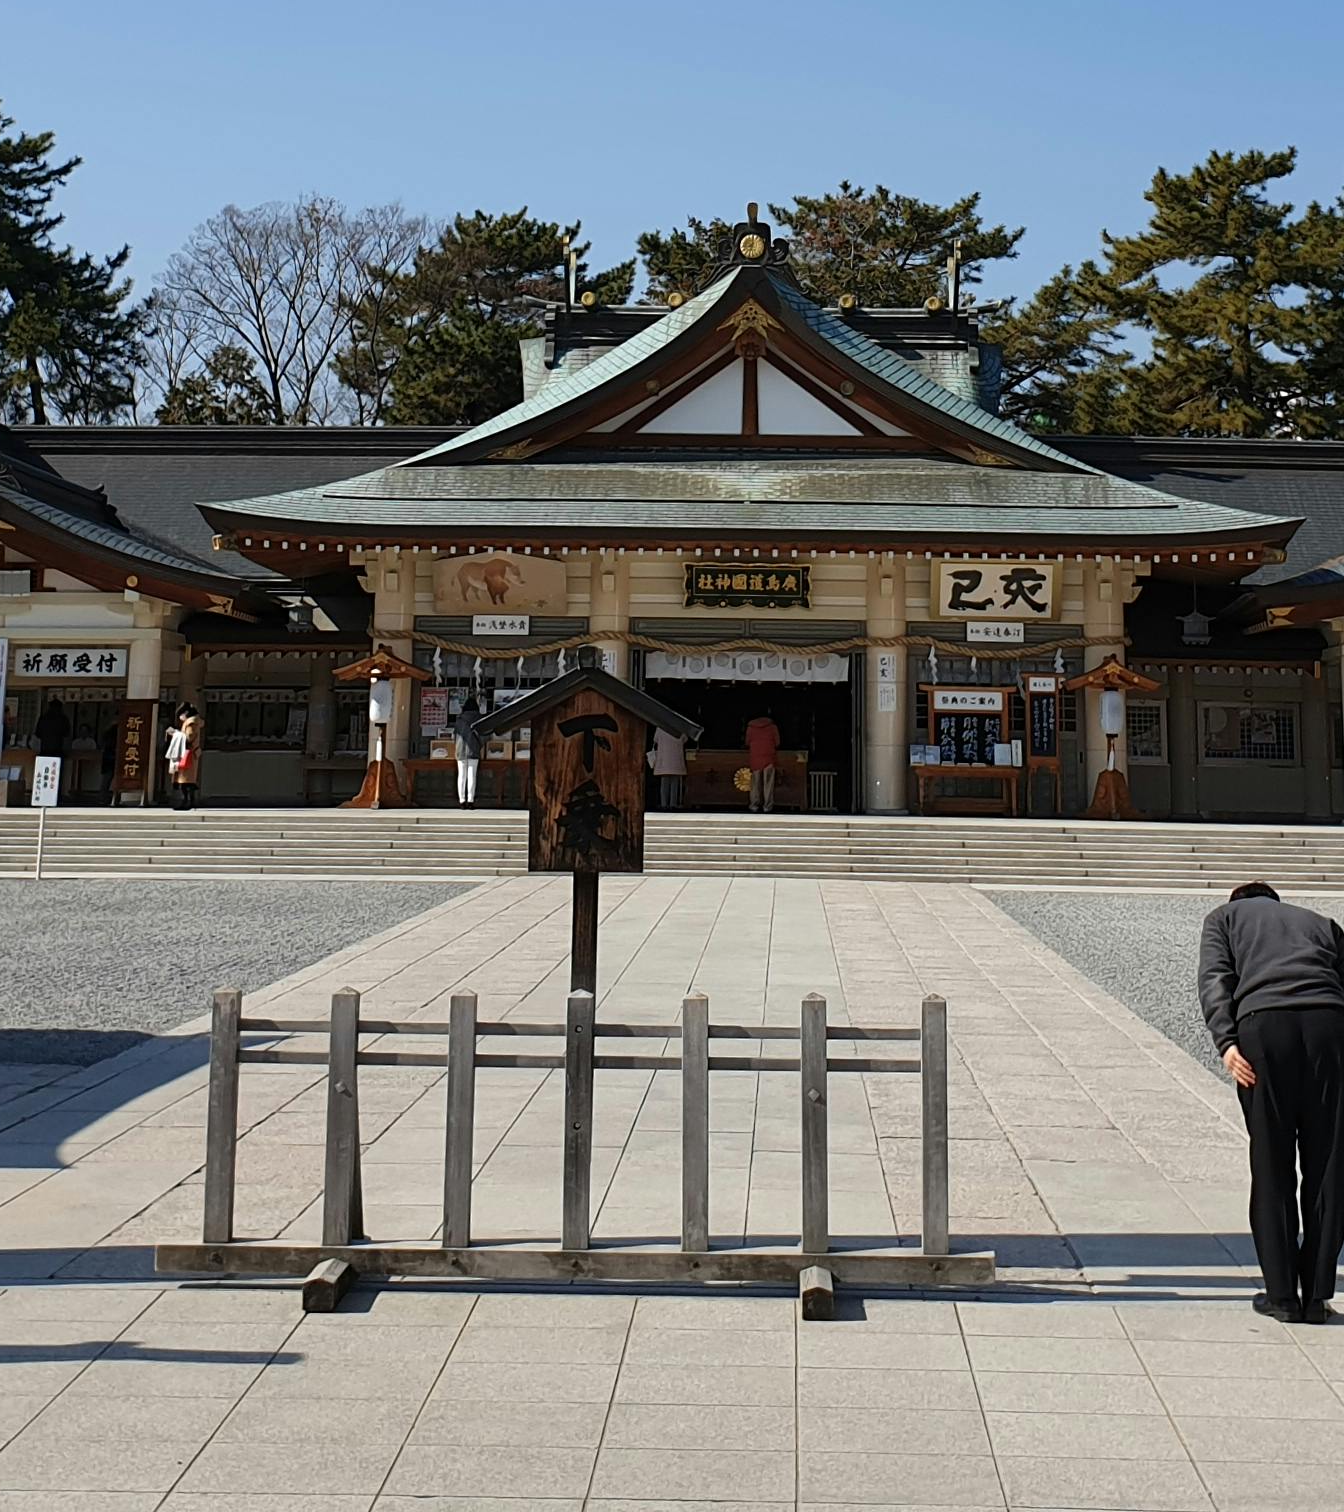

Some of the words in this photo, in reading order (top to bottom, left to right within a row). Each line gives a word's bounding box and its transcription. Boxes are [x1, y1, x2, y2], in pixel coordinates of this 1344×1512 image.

[22, 652, 118, 674] 祈願受付
[123, 716, 144, 777] 祈願受付
